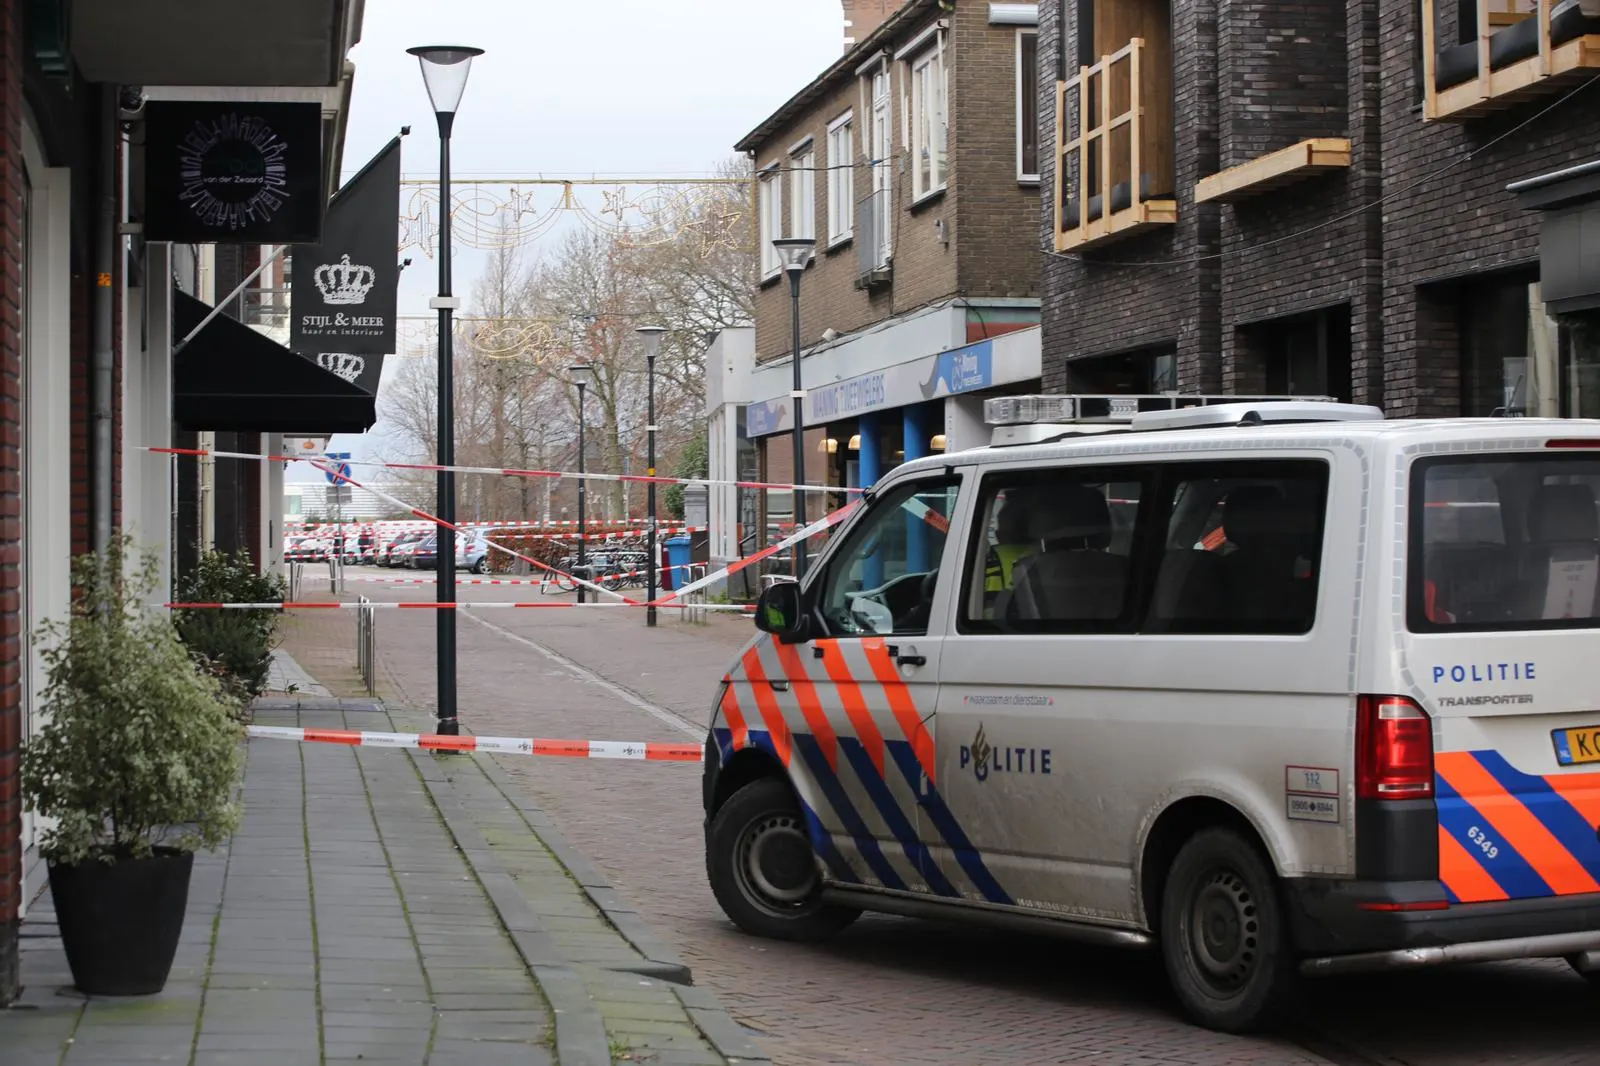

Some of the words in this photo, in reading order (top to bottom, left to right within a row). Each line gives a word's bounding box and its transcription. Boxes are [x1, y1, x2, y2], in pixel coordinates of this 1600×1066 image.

[303, 316, 332, 328] STIJL
[334, 312, 350, 326] &
[352, 317, 384, 327] MEER
[1433, 662, 1535, 683] POLITIE
[1438, 694, 1534, 707] TRANSPORTER
[960, 745, 1051, 781] POLITIE
[1468, 826, 1498, 858] 6349
